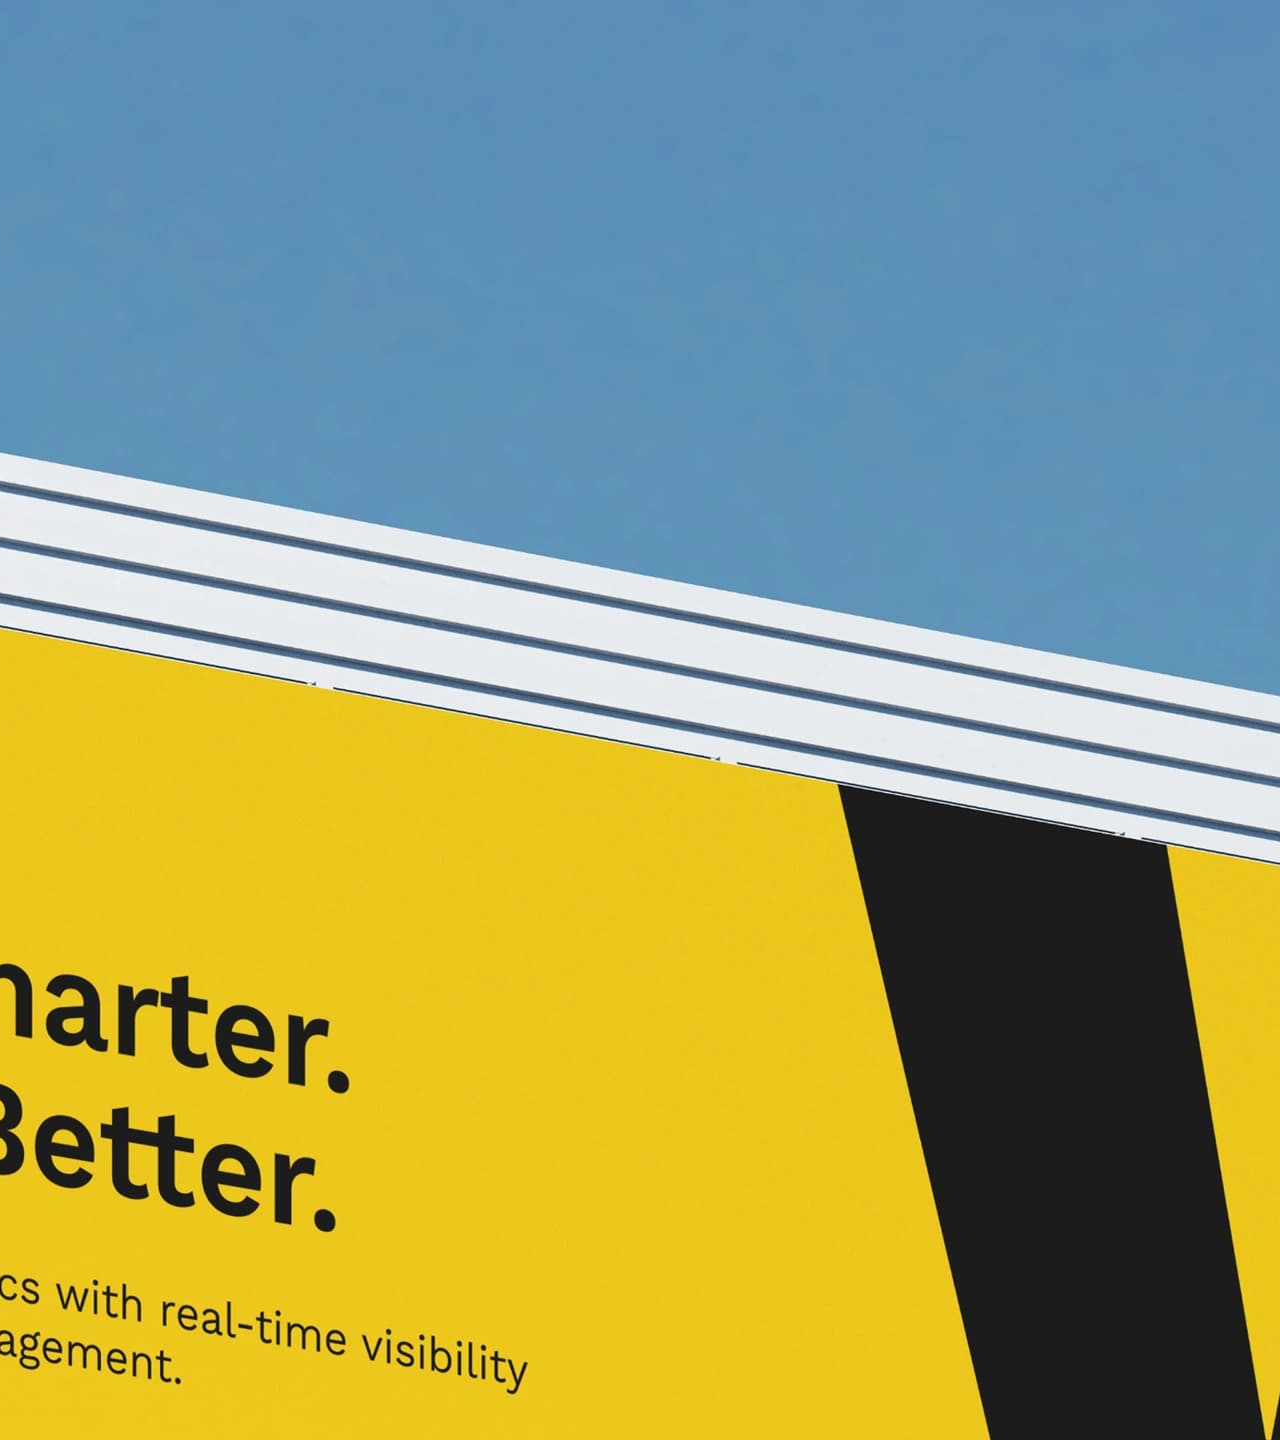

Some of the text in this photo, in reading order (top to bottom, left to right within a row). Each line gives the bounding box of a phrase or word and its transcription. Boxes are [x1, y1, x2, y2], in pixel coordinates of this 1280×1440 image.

[55, 1279, 142, 1323] with
[162, 1300, 347, 1356] real-time
[361, 1328, 529, 1395] visibility
